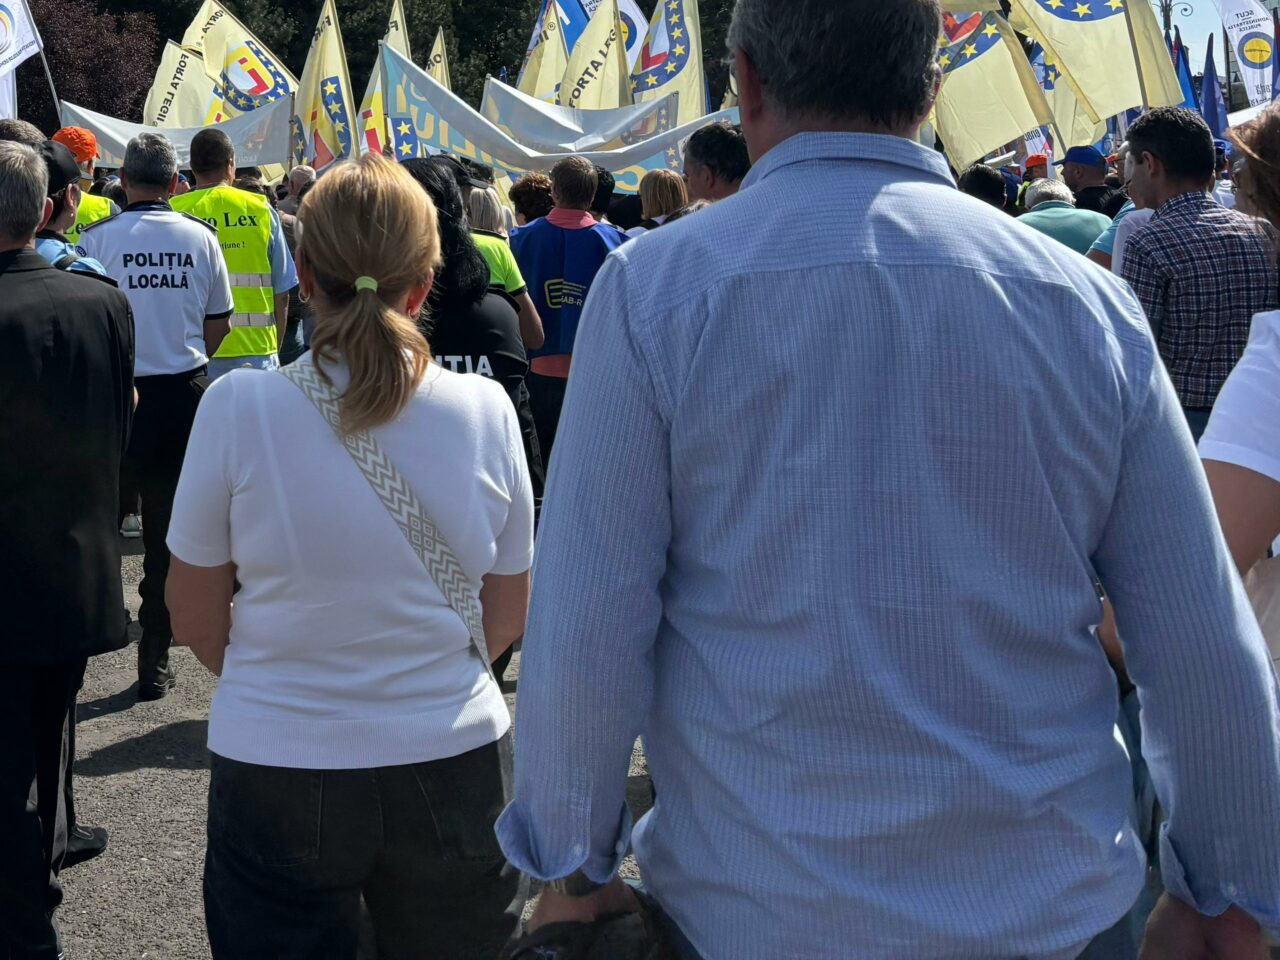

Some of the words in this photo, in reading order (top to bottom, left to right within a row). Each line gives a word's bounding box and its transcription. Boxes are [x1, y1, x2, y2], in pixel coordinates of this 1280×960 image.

[223, 212, 258, 228] Lex
[123, 253, 194, 271] POLIȚIA
[128, 271, 189, 290] LOCALĂ
